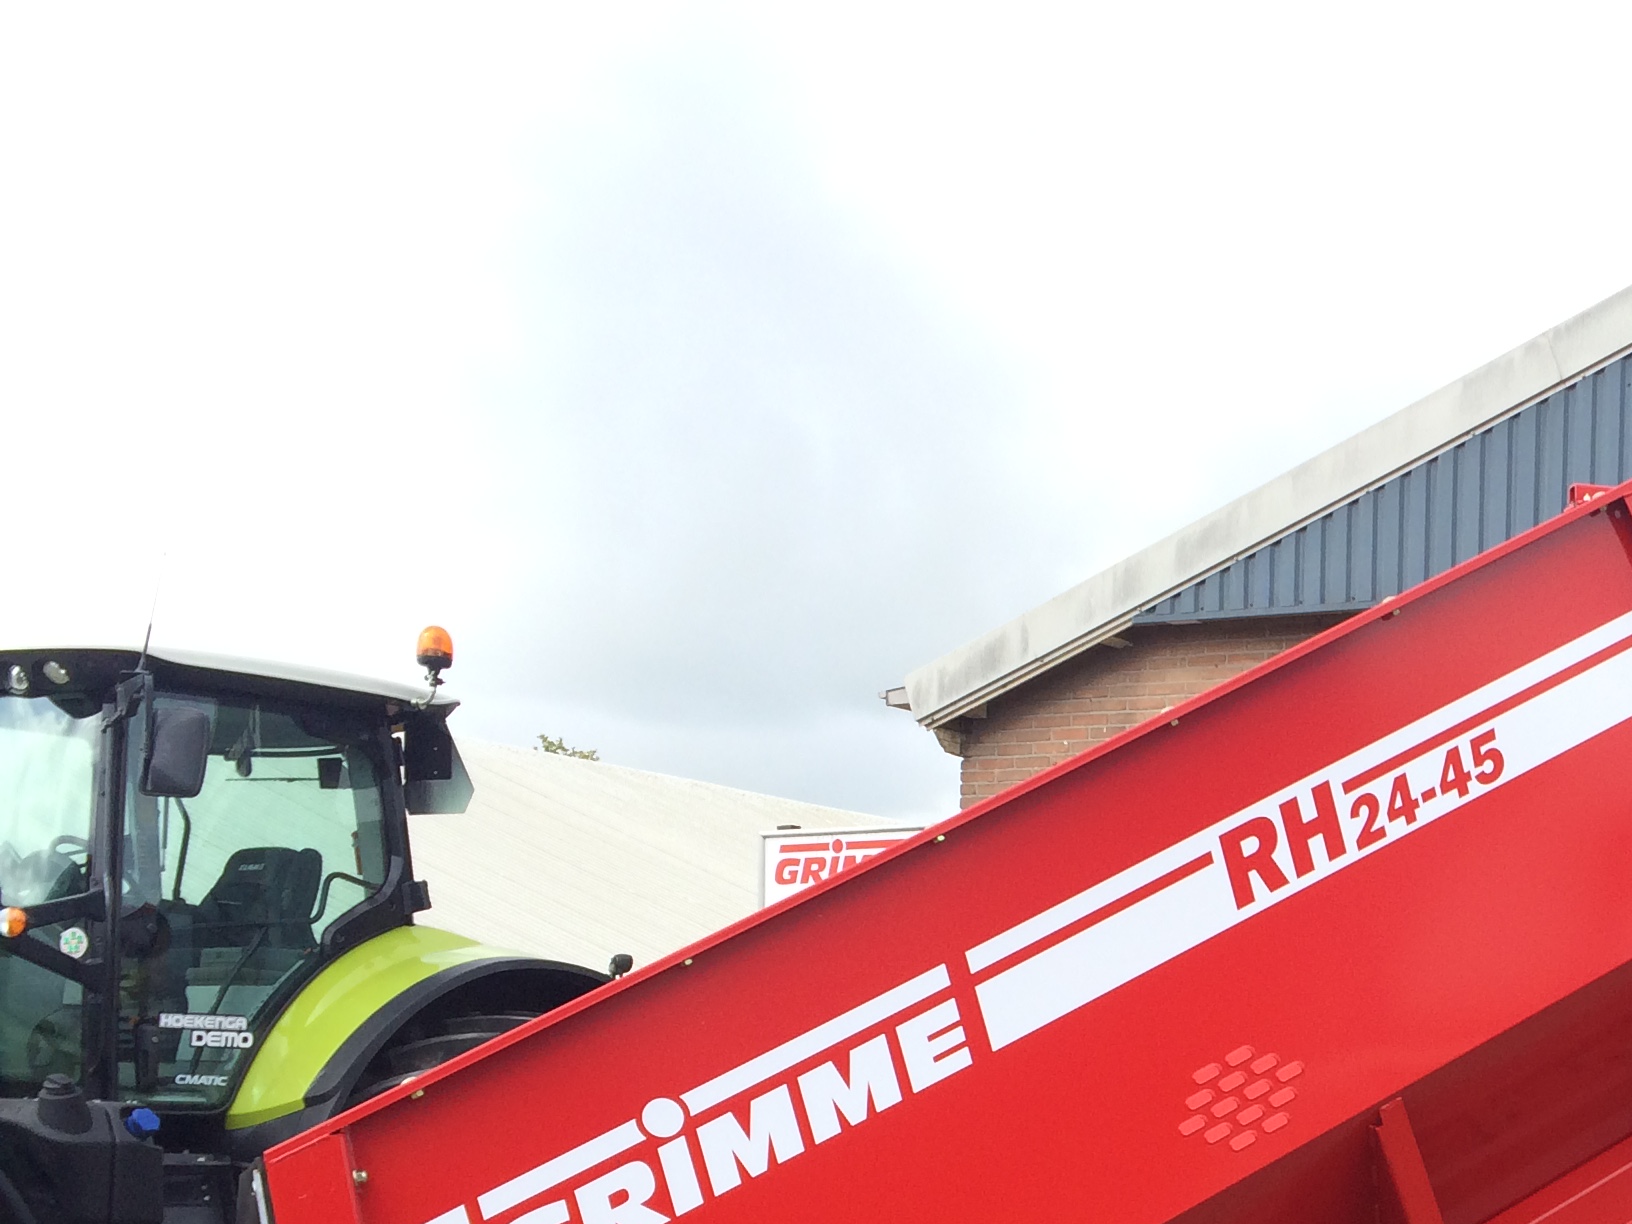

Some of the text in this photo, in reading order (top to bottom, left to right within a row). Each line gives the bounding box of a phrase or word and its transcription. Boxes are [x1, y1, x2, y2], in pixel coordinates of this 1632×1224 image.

[159, 1012, 248, 1031] HOEKENGA
[190, 1030, 254, 1049] DEMO
[174, 1074, 228, 1086] CMATIC
